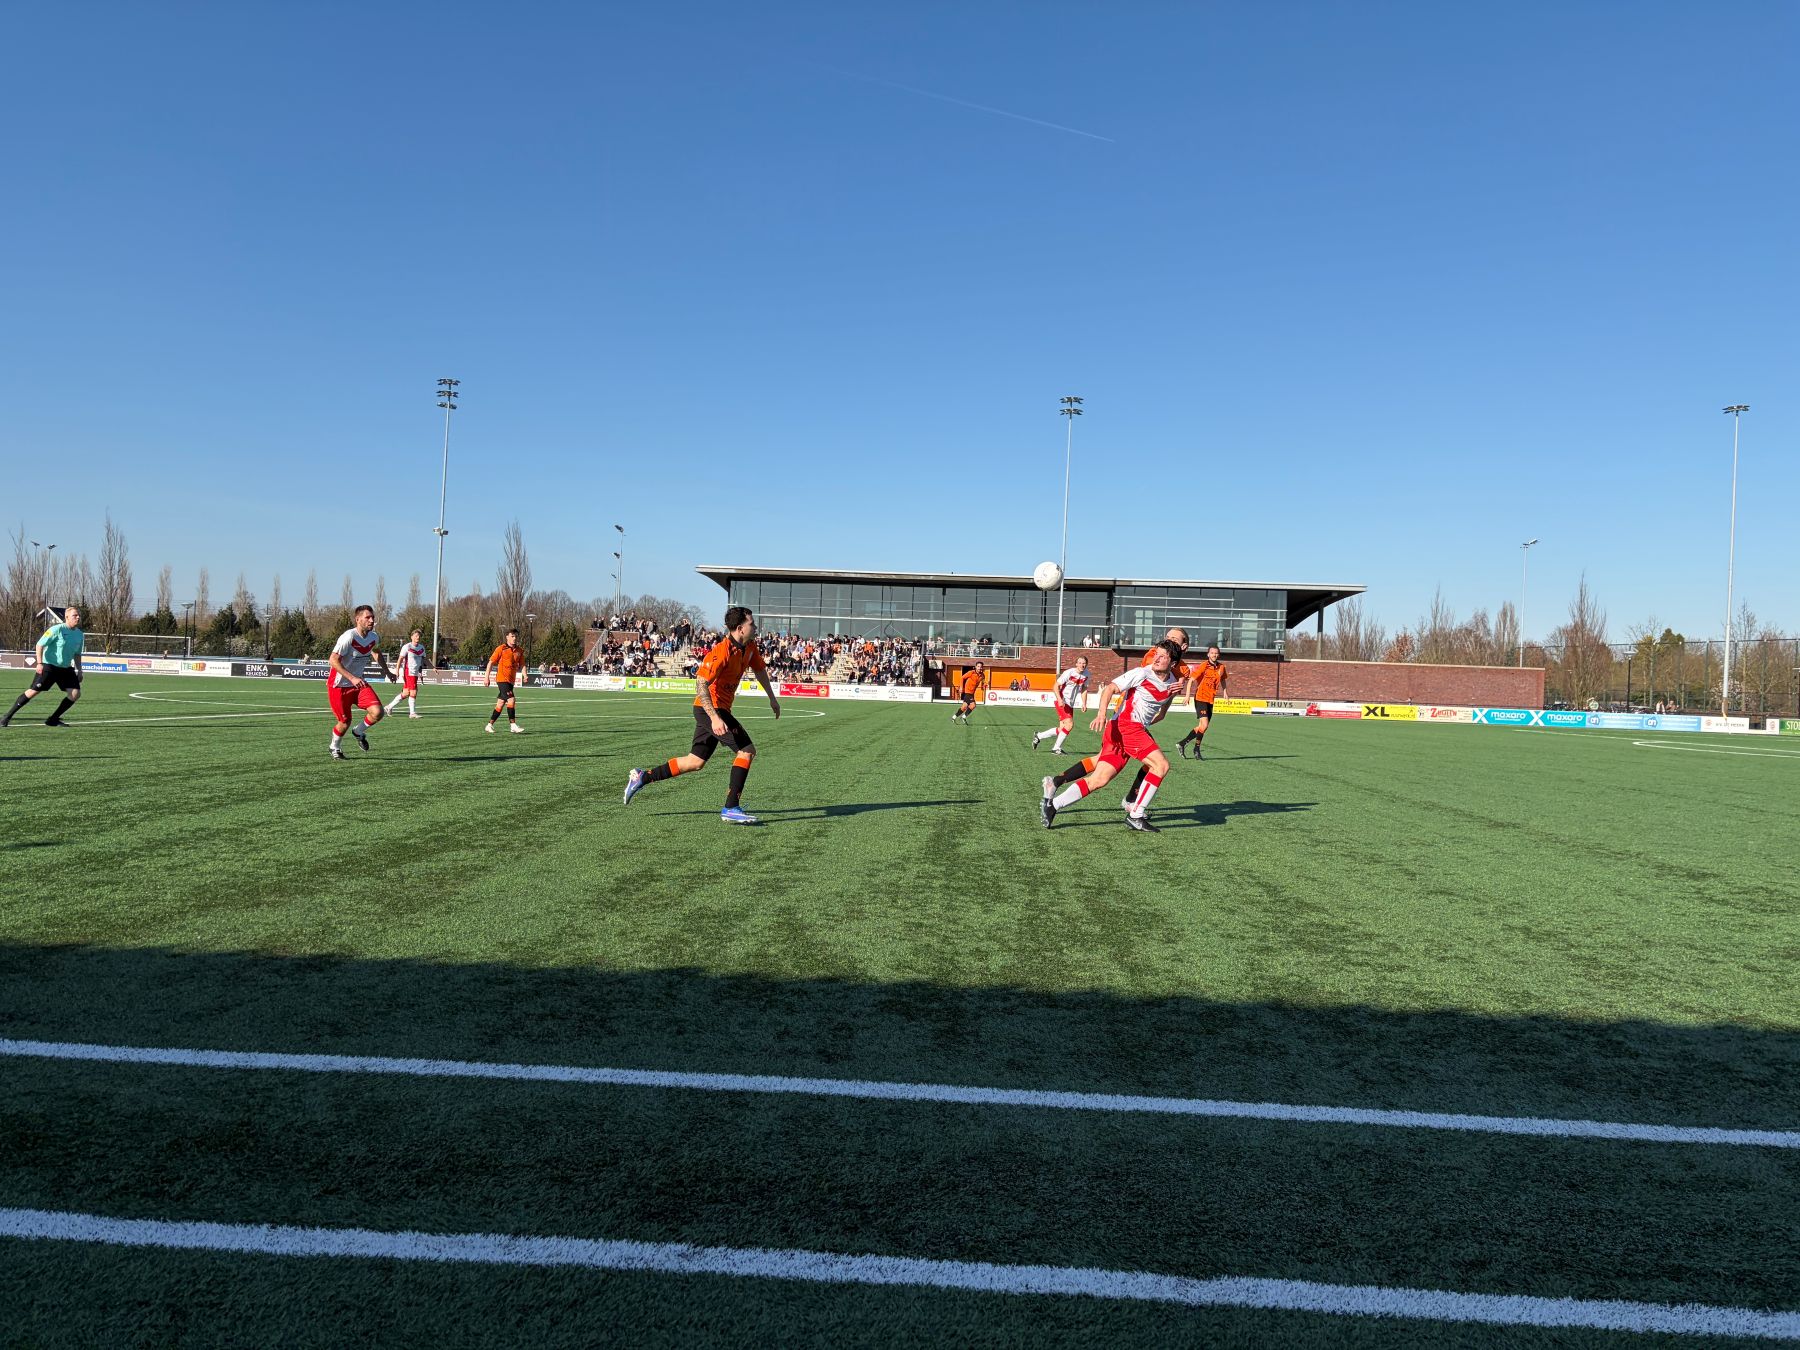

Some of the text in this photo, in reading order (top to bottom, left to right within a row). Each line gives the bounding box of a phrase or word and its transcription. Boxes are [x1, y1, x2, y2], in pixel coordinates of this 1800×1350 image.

[246, 664, 268, 672] ENKA
[284, 667, 330, 677] PonCente
[637, 680, 669, 690] PLUS
[1364, 706, 1389, 717] XL
[1491, 711, 1526, 719] maxaro
[1547, 713, 1583, 722] maxaro
